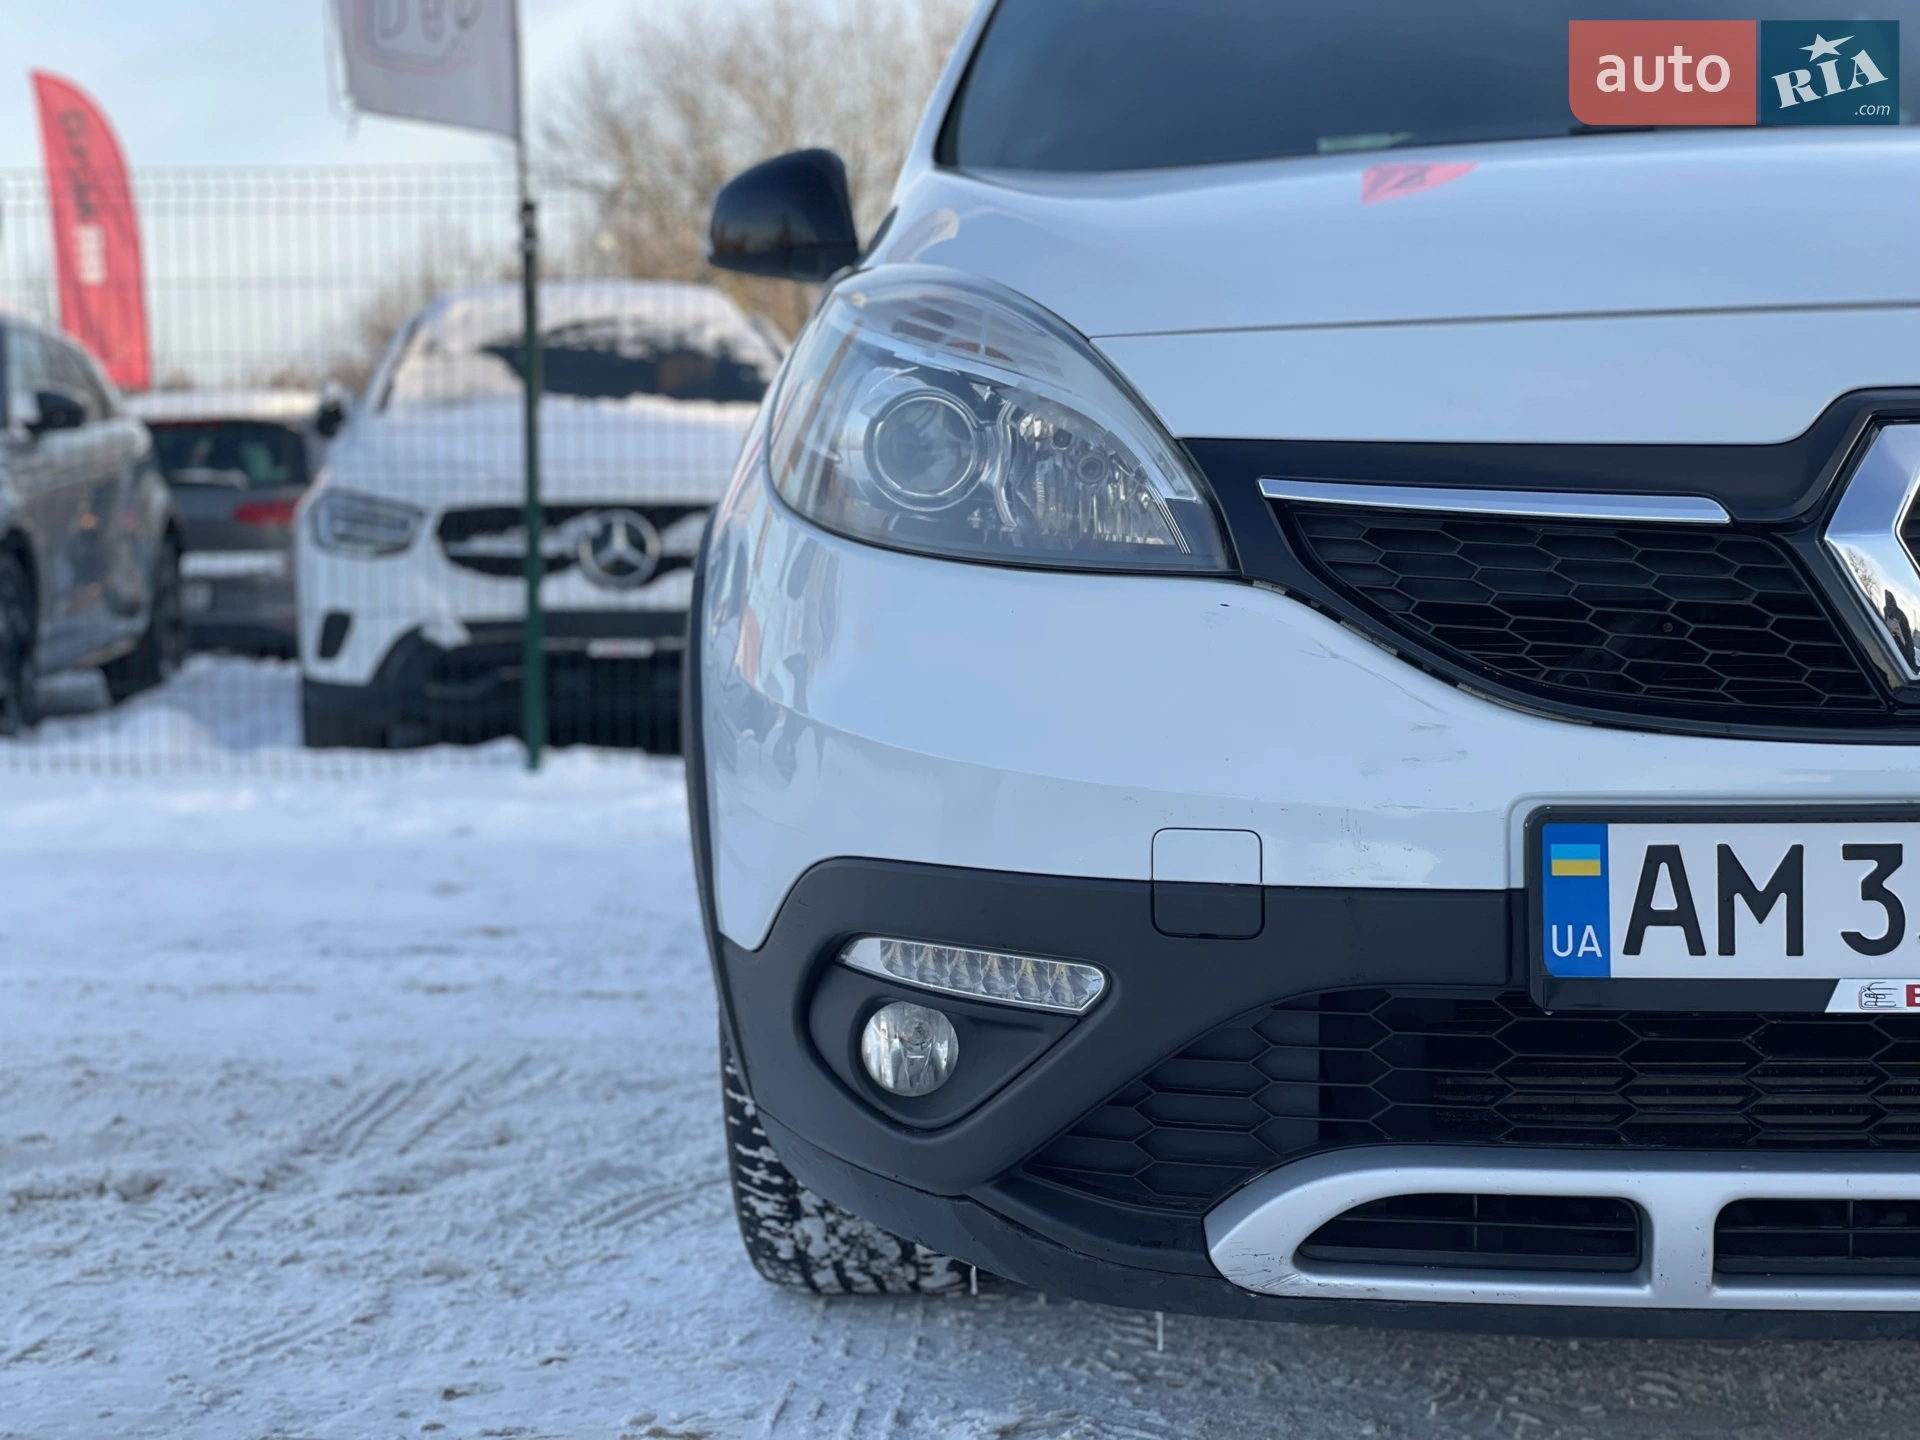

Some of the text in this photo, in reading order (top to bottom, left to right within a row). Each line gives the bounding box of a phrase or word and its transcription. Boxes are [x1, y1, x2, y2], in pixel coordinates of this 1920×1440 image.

[1622, 842, 1920, 957] AM 3
[1551, 924, 1603, 958] UA
